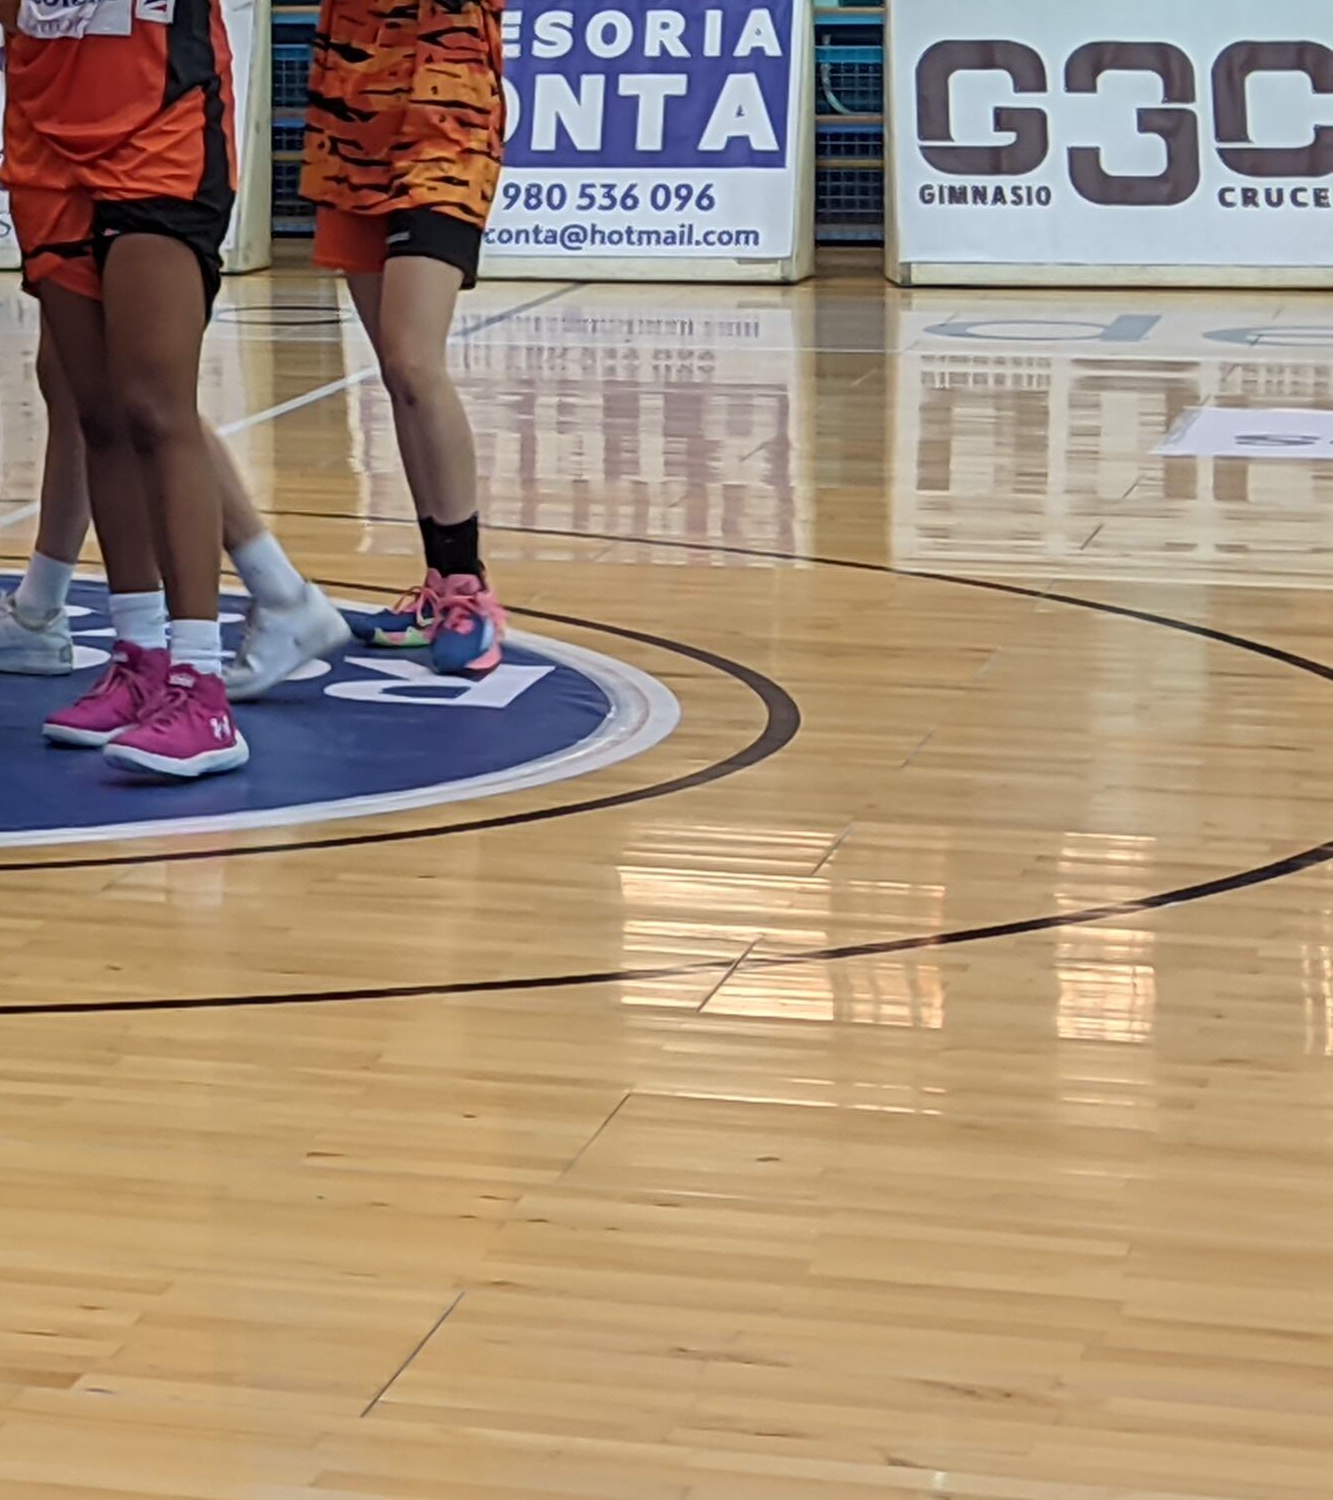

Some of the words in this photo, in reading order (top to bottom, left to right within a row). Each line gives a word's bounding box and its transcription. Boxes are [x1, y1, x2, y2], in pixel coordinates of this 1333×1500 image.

[502, 182, 568, 211] 980
[576, 182, 641, 211] 536
[650, 182, 716, 211] 096
[919, 183, 1052, 206] GIMNASIO
[1218, 186, 1330, 209] CRUCE
